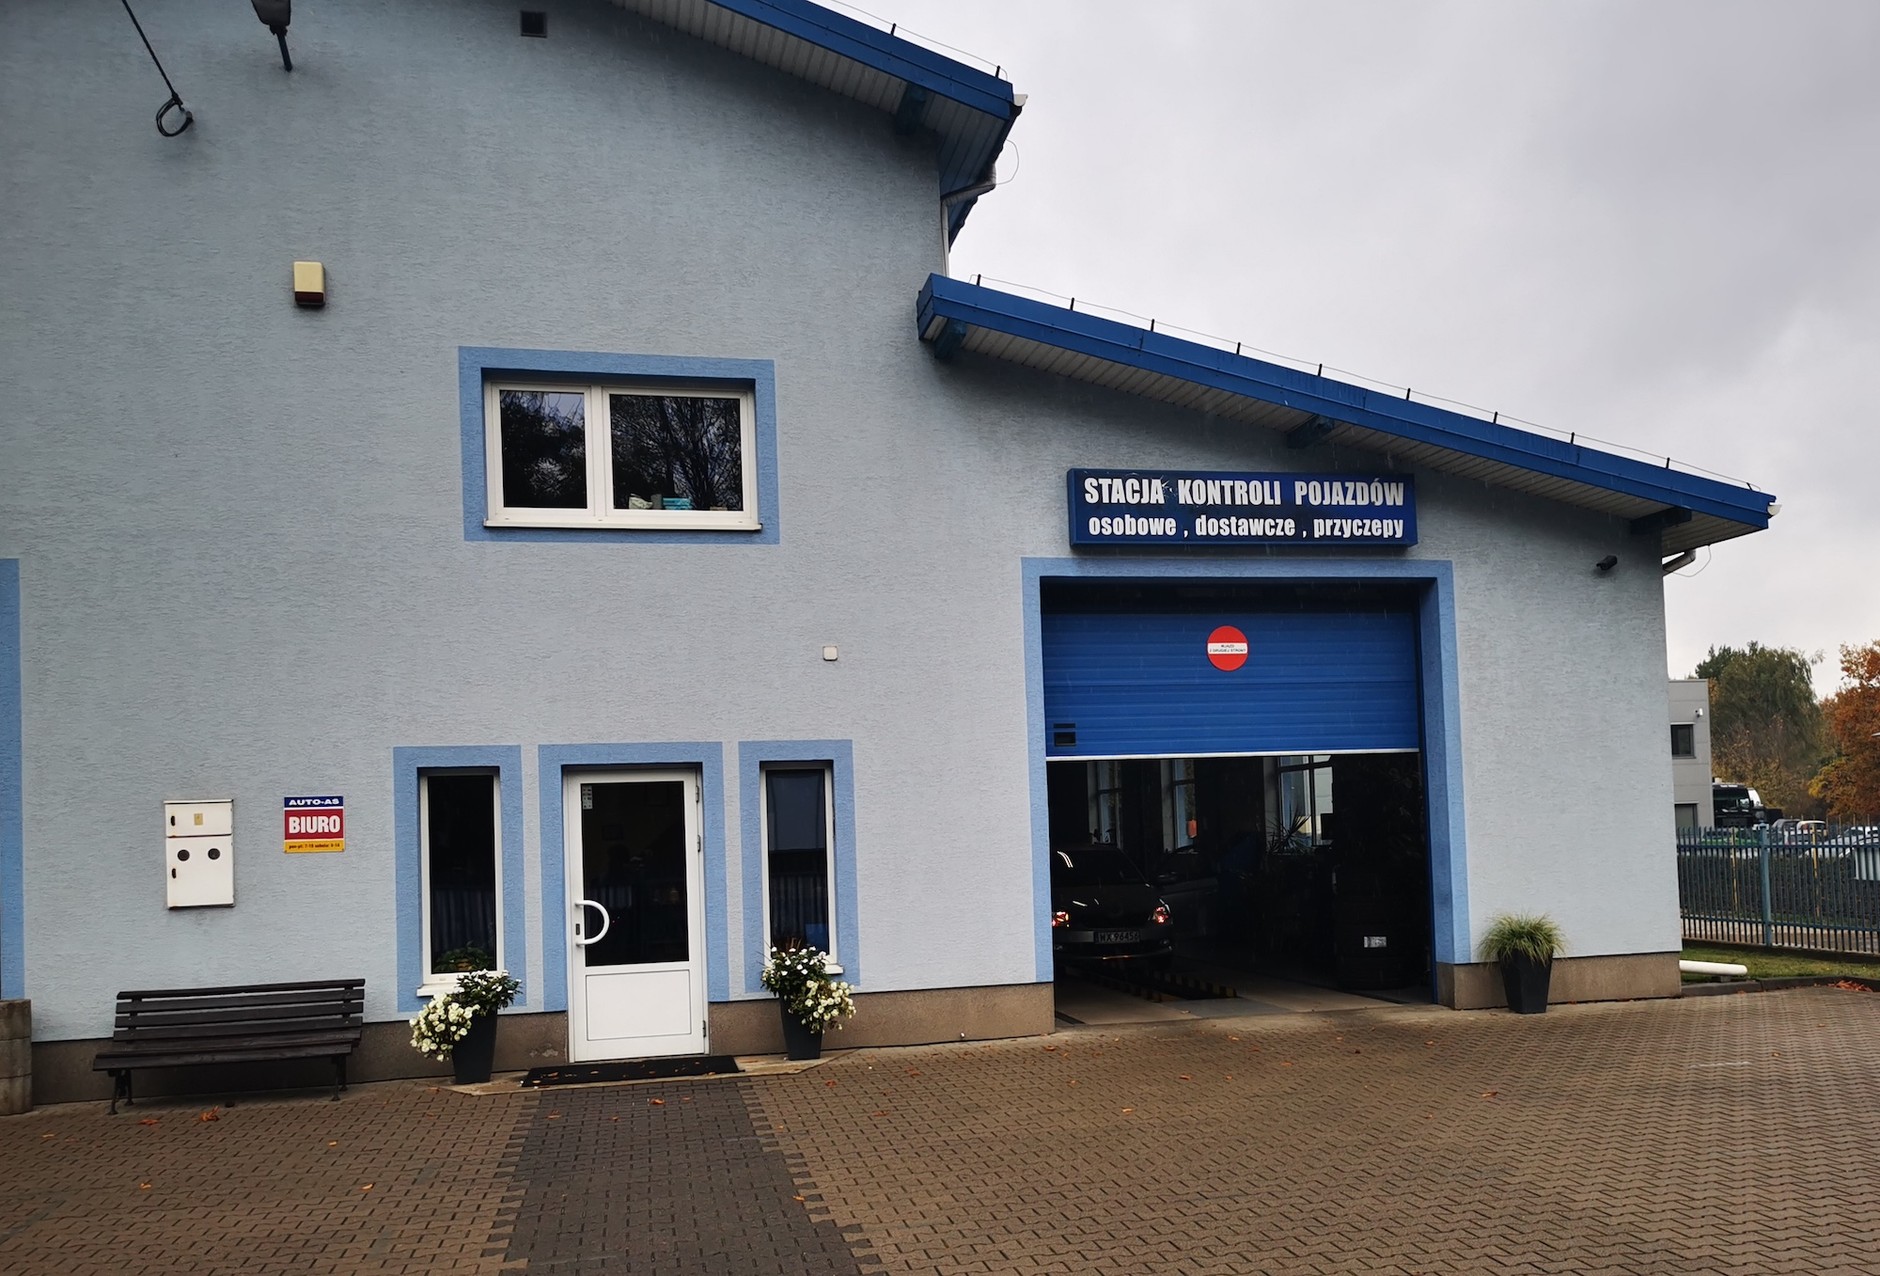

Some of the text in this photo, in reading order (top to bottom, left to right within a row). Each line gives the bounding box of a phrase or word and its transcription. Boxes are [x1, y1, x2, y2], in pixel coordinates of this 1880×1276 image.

[1084, 477, 1404, 506] STACJA KONTROLI POJAZDÓW
[1088, 514, 1176, 536] osobowe
[1195, 515, 1296, 537] dostawcze
[1313, 518, 1404, 539] przyczepy
[288, 798, 340, 806] AUTO-AS
[288, 815, 341, 834] BIURO
